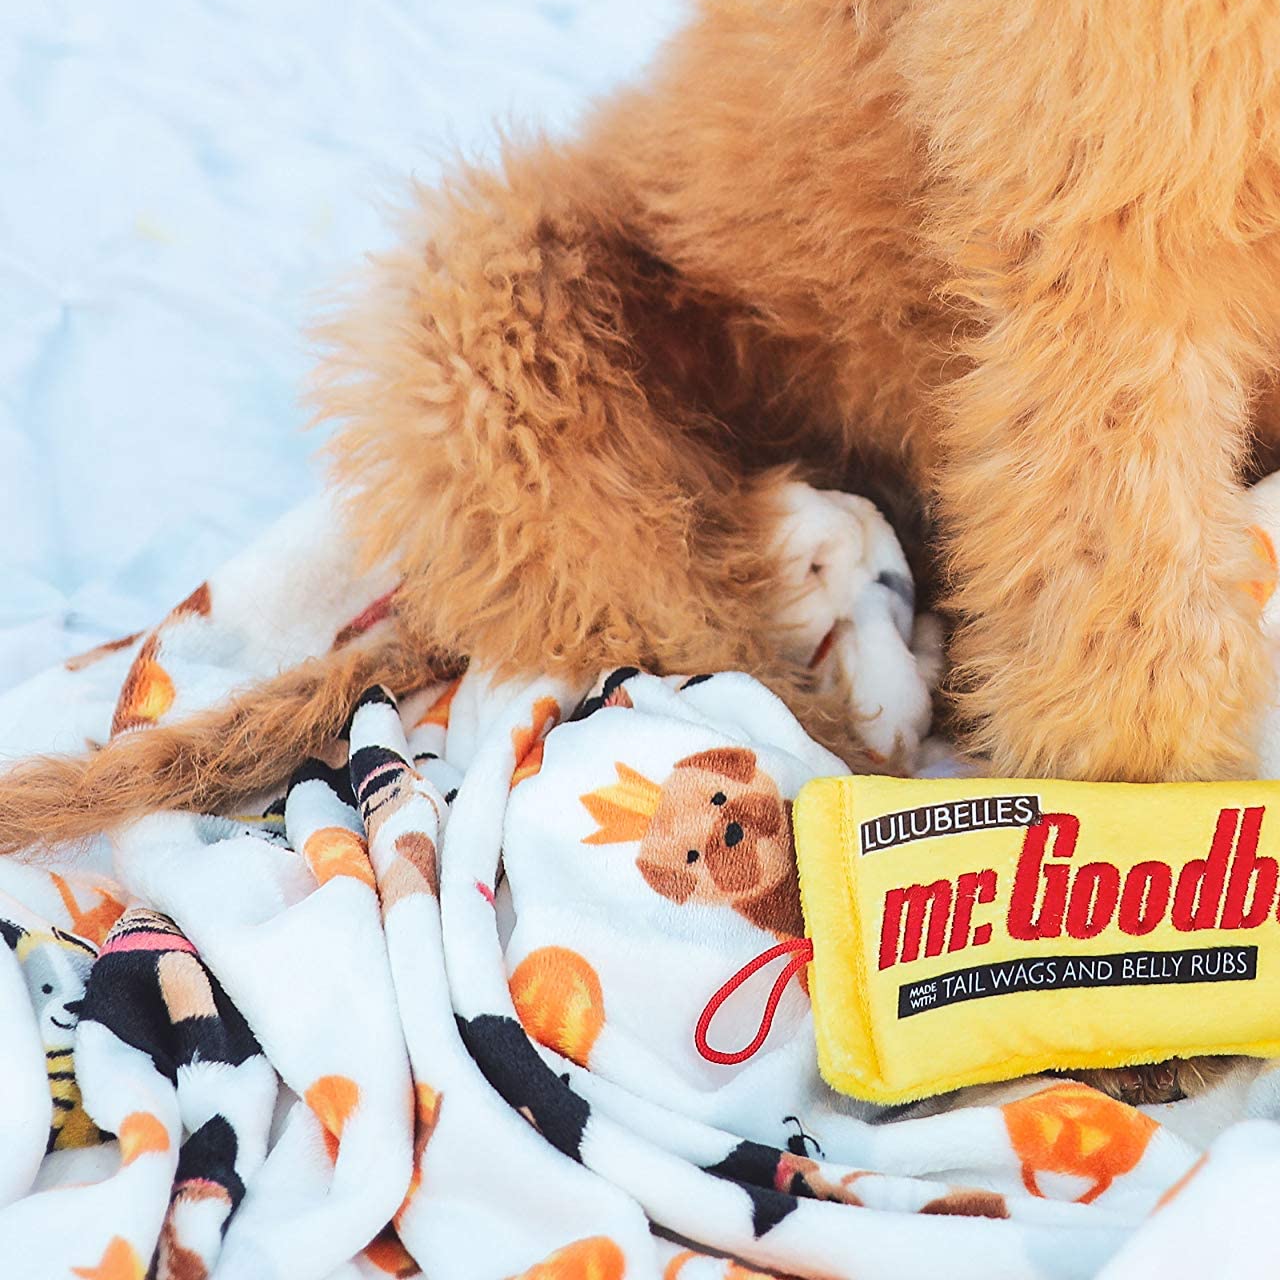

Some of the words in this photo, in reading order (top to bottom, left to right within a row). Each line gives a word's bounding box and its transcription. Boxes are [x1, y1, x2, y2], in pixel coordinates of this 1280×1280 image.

[863, 797, 1033, 851] LULUBELLES
[878, 868, 998, 971] mr.
[909, 983, 937, 998] MADE
[941, 971, 987, 1000] TAIL
[990, 961, 1057, 990] WAGS
[1062, 957, 1113, 982] AND
[1122, 956, 1184, 980] BELLY
[1190, 951, 1248, 977] RUBS
[910, 994, 937, 1010] WITH
